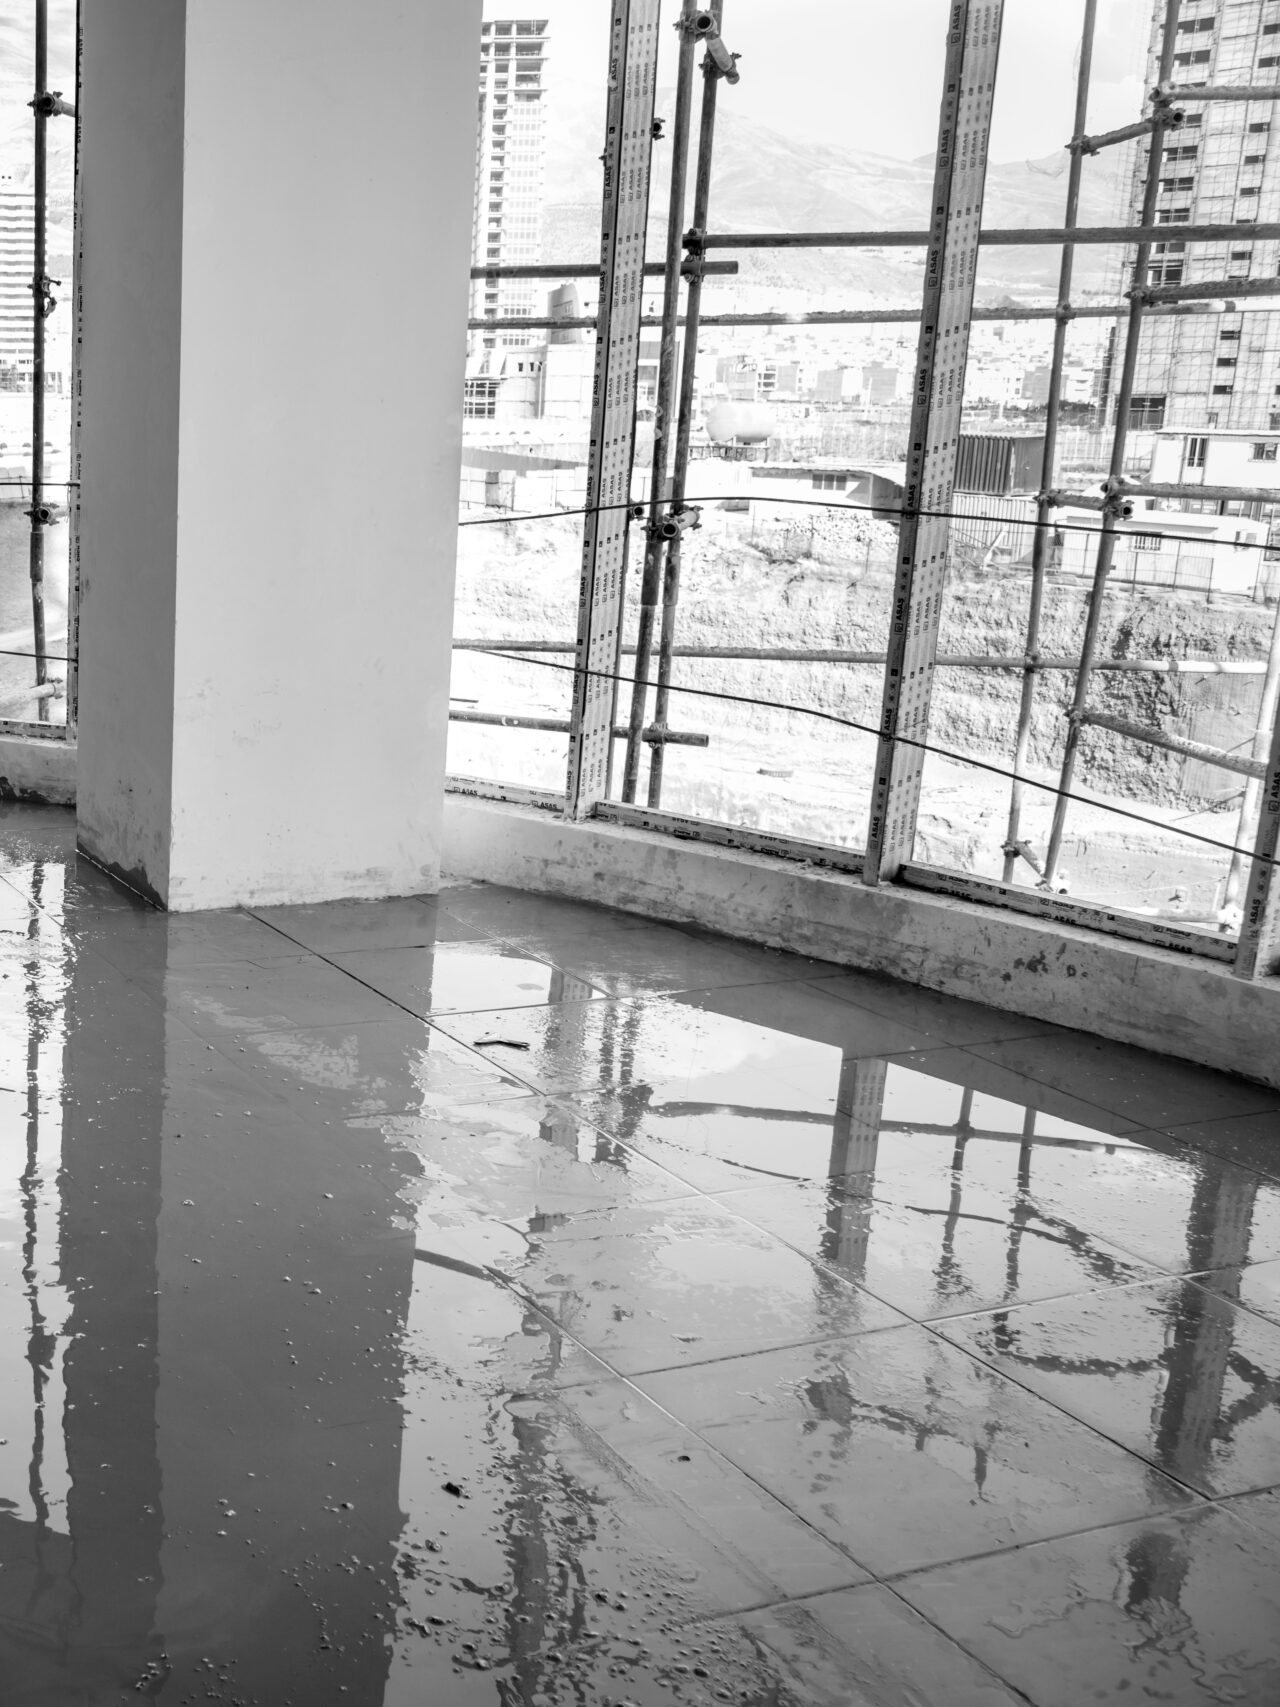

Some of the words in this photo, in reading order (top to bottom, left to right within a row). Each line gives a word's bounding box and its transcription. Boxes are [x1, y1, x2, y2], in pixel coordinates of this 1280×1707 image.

[953, 5, 961, 30] ASAS
[941, 129, 949, 153] ASAS
[930, 250, 938, 274] ASAS
[919, 369, 927, 392] ASAS
[907, 485, 916, 507] ASAS
[896, 598, 904, 620] ASAS
[884, 709, 893, 730] ASAS
[462, 788, 478, 796] ASAS
[1271, 772, 1280, 798] ASAS
[541, 801, 557, 809] ASAS
[872, 817, 880, 838] ASAS
[1250, 899, 1261, 925] ASAS
